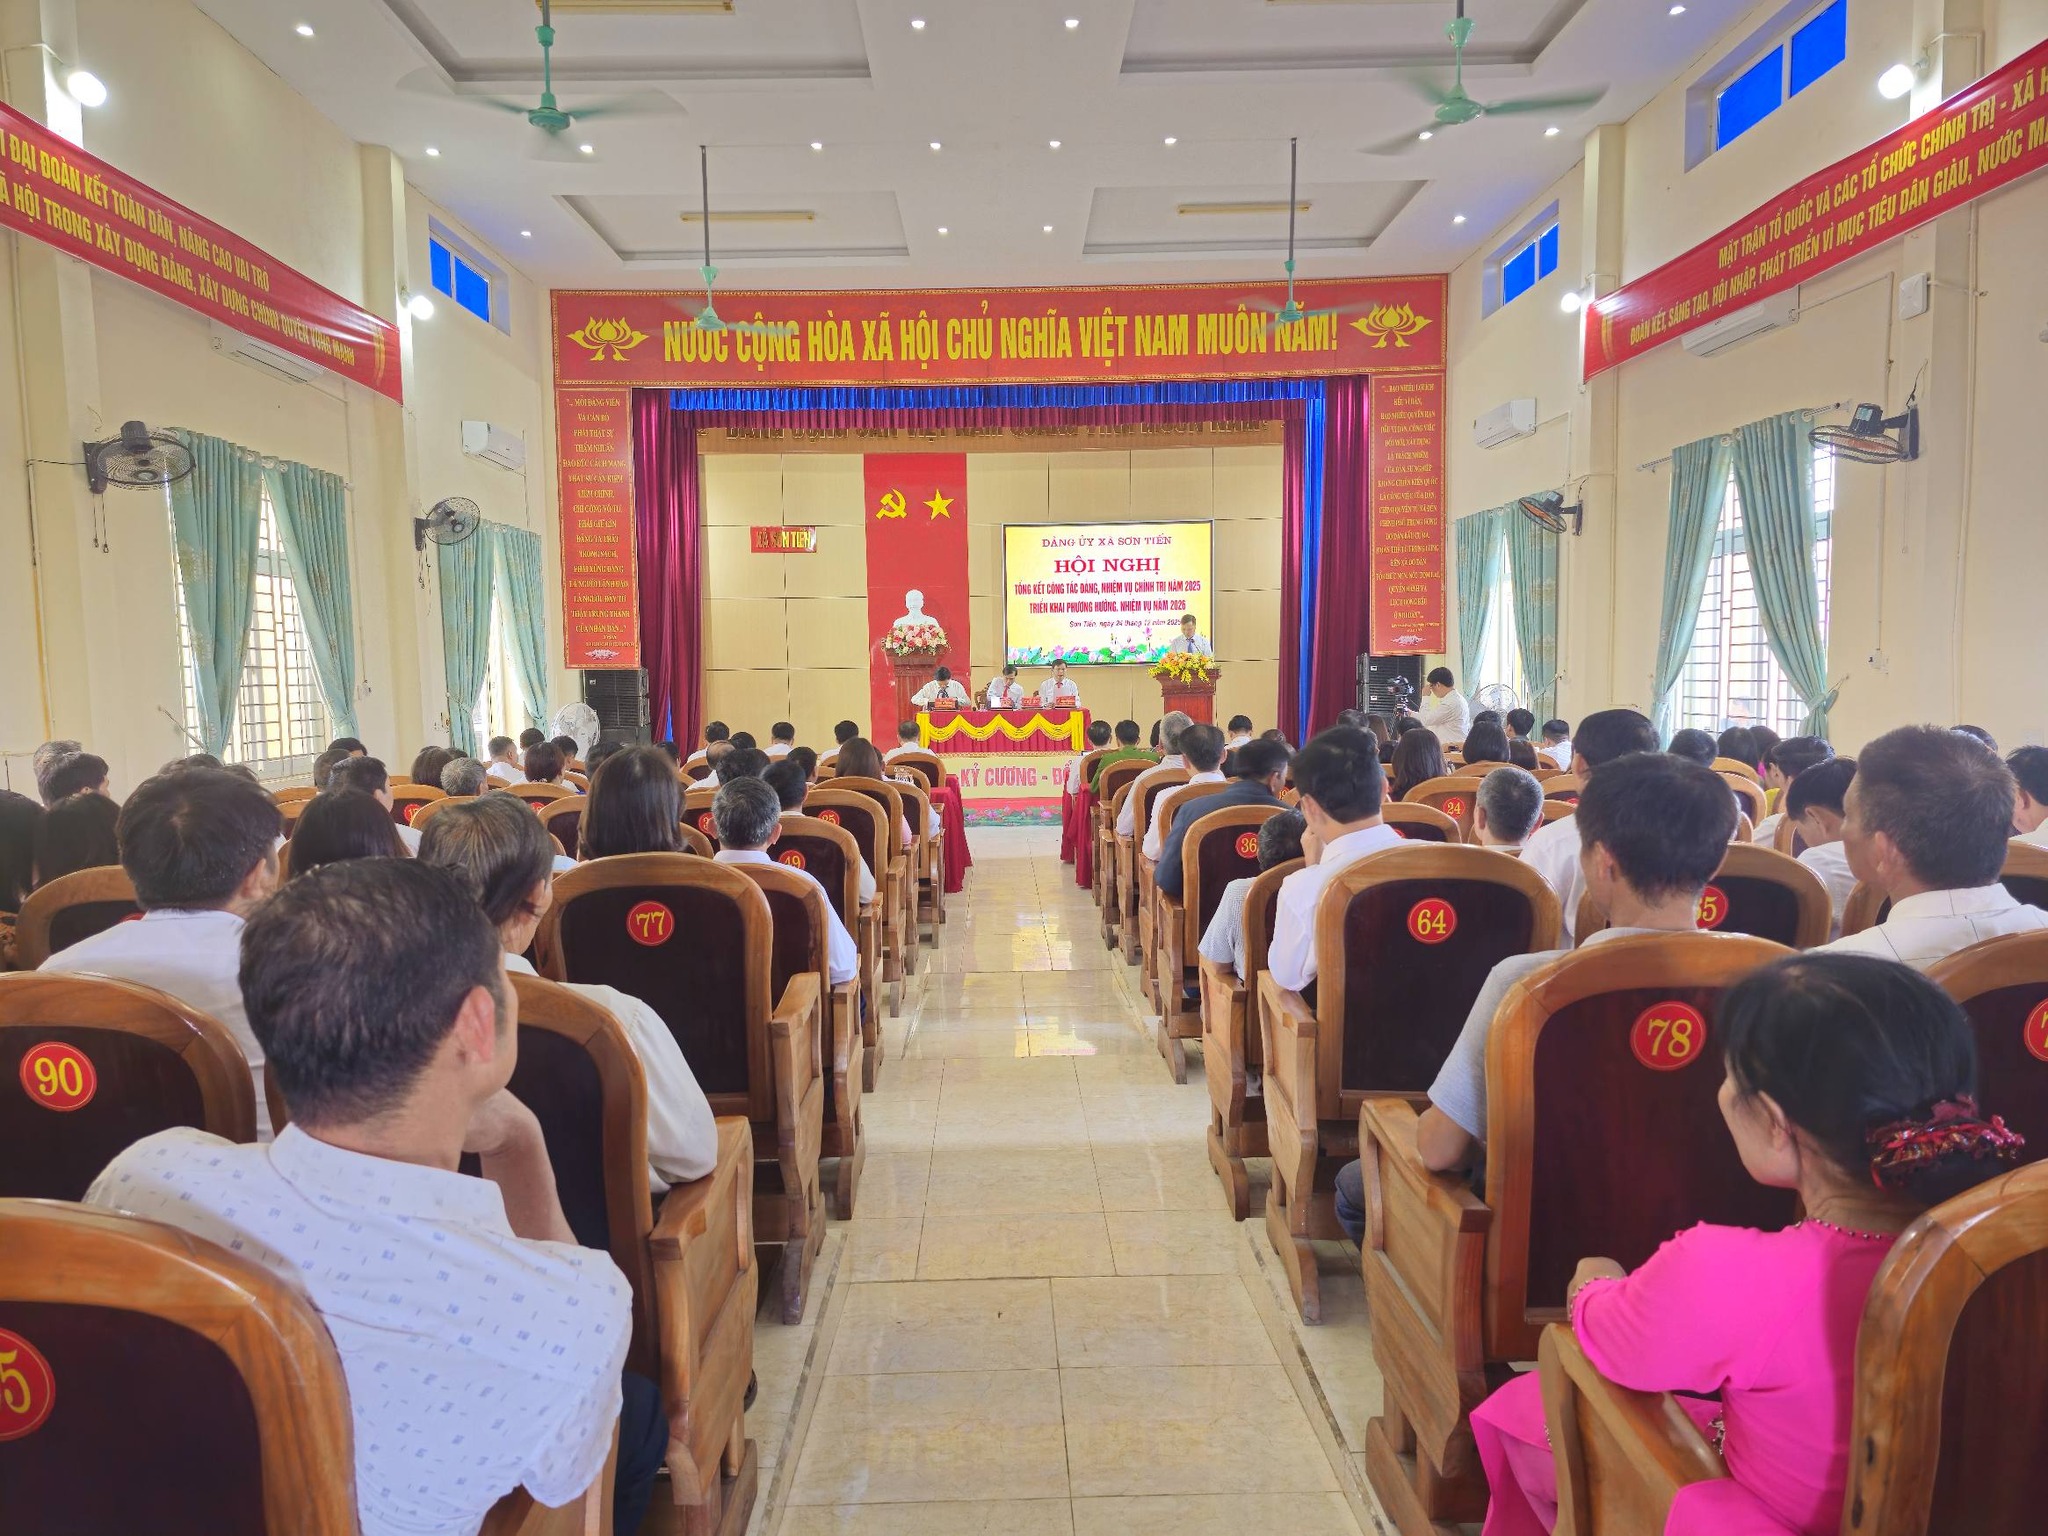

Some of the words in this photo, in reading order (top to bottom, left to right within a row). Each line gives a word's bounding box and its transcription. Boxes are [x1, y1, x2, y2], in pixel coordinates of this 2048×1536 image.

[1718, 238, 1739, 269] MẶT
[1741, 225, 1766, 257] TRẬN
[1769, 207, 1783, 242] TỔ
[1784, 199, 1812, 237] QUỐC
[1816, 184, 1831, 217] VÀ
[1833, 178, 1858, 208] CÁC
[1861, 155, 1879, 195] TỔ
[1880, 142, 1917, 182] CHỨC
[1920, 111, 1967, 160] CHÍNH
[1971, 94, 1996, 133] TRỊ
[2010, 67, 2035, 112] XÃ
[9, 133, 37, 175] ĐẠI
[40, 149, 81, 195] ĐOÀN
[84, 173, 109, 208] KẾT
[113, 190, 146, 232] TOÀN
[148, 209, 177, 248] DÂN,
[179, 226, 210, 262] NÂNG
[212, 241, 233, 272] CAO
[234, 255, 250, 282] VAI
[252, 265, 270, 292] TRÒ
[1668, 298, 1690, 327] SÁNG
[1712, 279, 1728, 308] HỘI
[1759, 248, 1785, 283] PHÁT
[1788, 227, 1819, 269] TRIỂN
[1822, 219, 1835, 254] VÌ
[1836, 212, 1865, 250] MỤC
[1868, 194, 1896, 234] TIÊU
[1899, 178, 1928, 216] DÂN
[1933, 156, 1972, 200] GIÀU,
[1977, 127, 2023, 176] NƯỚC
[13, 183, 40, 223] HỘI
[43, 197, 92, 243] TRONG
[94, 222, 121, 255] XÂY
[124, 240, 159, 276] DỰNG
[160, 252, 197, 295] ĐẢNG,
[199, 273, 219, 303] XÂY
[221, 287, 249, 317] DỰNG
[251, 300, 280, 331] CHÍNH
[736, 311, 801, 372] CỘNG
[807, 311, 856, 362] HÒA
[861, 311, 894, 361] XÃ
[900, 310, 940, 370] HỘI
[946, 299, 992, 361] CHỦ
[1000, 307, 1073, 360] NGHĨA
[1078, 307, 1128, 368] VIỆT
[1134, 313, 1189, 357] NAM
[1197, 303, 1267, 355] MUÔN
[1274, 301, 1338, 353] NĂM!
[1042, 536, 1076, 548] ĐẢNG
[1079, 534, 1095, 547] ỦY
[1117, 536, 1141, 546] SƠN
[1144, 533, 1172, 546] TIẾN
[1054, 555, 1096, 576] HỘI
[1102, 557, 1161, 575] NGHỊ
[1033, 580, 1045, 594] KẾT
[1046, 581, 1065, 595] CÔNG
[1066, 580, 1079, 594] TÁC
[1101, 579, 1123, 596] NHIỆM
[1124, 582, 1133, 595] VỤ
[1134, 579, 1154, 592] CHÍNH
[1156, 581, 1166, 594] TRỊ
[1168, 579, 1183, 592] NĂM
[1185, 580, 1201, 592] 2025
[1029, 598, 1048, 614] TRIỂN
[1049, 602, 1065, 613] KHAI
[1066, 601, 1093, 613] PHƯƠNG
[1120, 598, 1142, 614] NHIỆM
[1143, 601, 1152, 614] VỤ
[1153, 598, 1169, 611] NĂM
[1170, 600, 1186, 611] 2026
[960, 762, 980, 787] KỶ
[985, 765, 1038, 787] CƯƠNG
[1447, 802, 1461, 816] 24
[1241, 837, 1257, 853] 36
[635, 910, 666, 937] 77
[1416, 907, 1447, 936] 64
[1646, 1017, 1692, 1058] 78
[35, 1056, 84, 1096] 90
